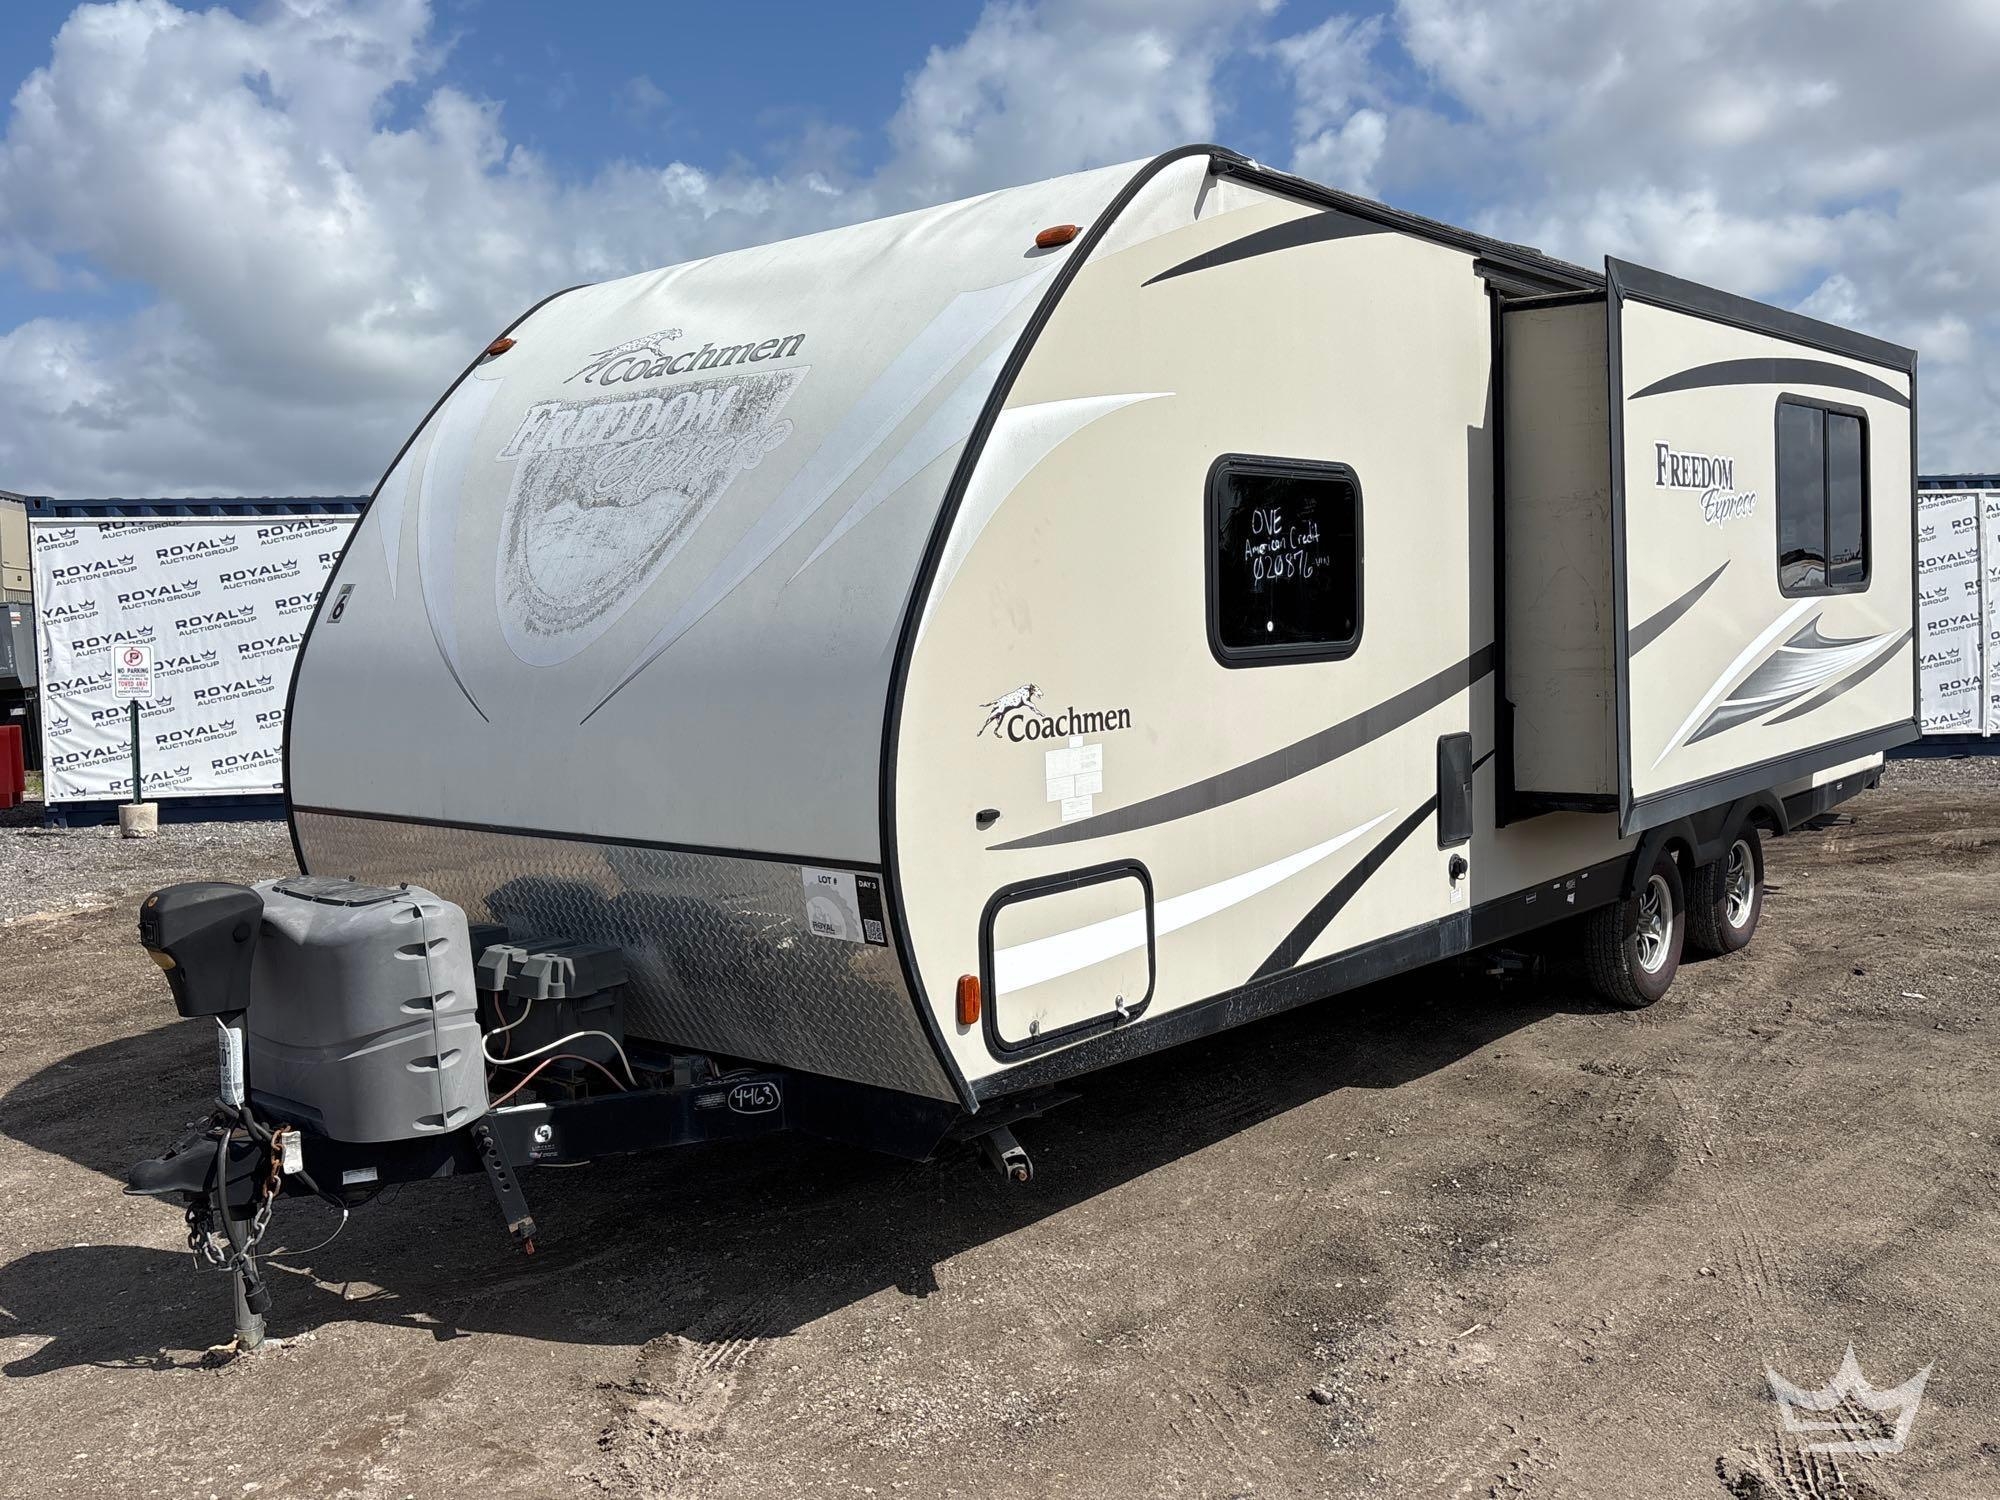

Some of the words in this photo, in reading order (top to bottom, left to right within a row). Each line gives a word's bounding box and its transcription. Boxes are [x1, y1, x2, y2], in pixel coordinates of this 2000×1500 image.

[600, 333, 806, 386] Coachmen
[1940, 496, 1967, 505] GROUP
[102, 527, 146, 540] AUCTION
[148, 521, 182, 531] GROUP
[257, 520, 320, 539] ROYAL
[1252, 507, 1282, 536] OVE
[260, 533, 303, 546] AUCTION
[305, 525, 338, 537] GROUP
[1290, 521, 1320, 549] Credit
[43, 539, 80, 551] GROUP
[156, 539, 220, 559] ROYAL
[160, 552, 203, 566] AUCTION
[204, 545, 239, 557] GROUP
[1918, 552, 1966, 568] ROYAL
[52, 559, 119, 579] ROYAL
[56, 573, 101, 586] AUCTION
[102, 565, 138, 578] GROUP
[219, 564, 282, 583] ROYAL
[222, 577, 266, 590] AUCTION
[267, 570, 301, 582] GROUP
[117, 583, 183, 604] ROYAL
[121, 598, 165, 611] AUCTION
[166, 590, 201, 602] GROUP
[1921, 596, 1950, 606] GROUP
[42, 604, 80, 619] YAL
[63, 610, 99, 623] GROUP
[278, 603, 318, 616] AUCTIO
[175, 609, 239, 630] ROYAL
[178, 623, 222, 637] AUCTION
[223, 616, 257, 628] GROUP
[1927, 612, 1980, 631] ROYAL
[71, 629, 138, 650] ROYAL
[1929, 624, 1965, 637] AUCTION
[75, 645, 112, 658] AUCTIO
[237, 633, 301, 653] ROYAL
[154, 654, 201, 671] OYAL
[241, 647, 283, 660] AUCTION
[1933, 657, 1962, 668] GROUP
[154, 667, 184, 679] CTION
[185, 660, 220, 672] GROUP
[47, 675, 99, 693] OYAL
[83, 682, 112, 693] GROU
[193, 680, 257, 699] ROYAL
[1939, 675, 1982, 692] ROYA
[1941, 685, 1976, 698] AUCTION
[197, 693, 240, 707] AUCTION
[241, 685, 275, 697] GROUP
[95, 715, 131, 729] AUCTIO
[140, 706, 176, 718] GROUP
[1007, 706, 1132, 743] Coachmen
[1920, 713, 1958, 728] OYAL
[1945, 718, 1973, 729] GROUP
[48, 728, 72, 738] OUP
[155, 724, 220, 745] ROYAL
[158, 738, 202, 751] AUCTION
[203, 730, 238, 742] GROUP
[52, 746, 118, 767] ROYAL
[55, 760, 100, 773] AUCTION
[101, 752, 134, 764] GROU
[211, 749, 274, 769] ROYAL
[214, 762, 257, 776] AUCTION
[258, 758, 283, 767] GRO
[158, 776, 193, 788] GROUP
[818, 875, 832, 884] LOT
[858, 880, 871, 888] DAY
[734, 1086, 774, 1108] 4463
